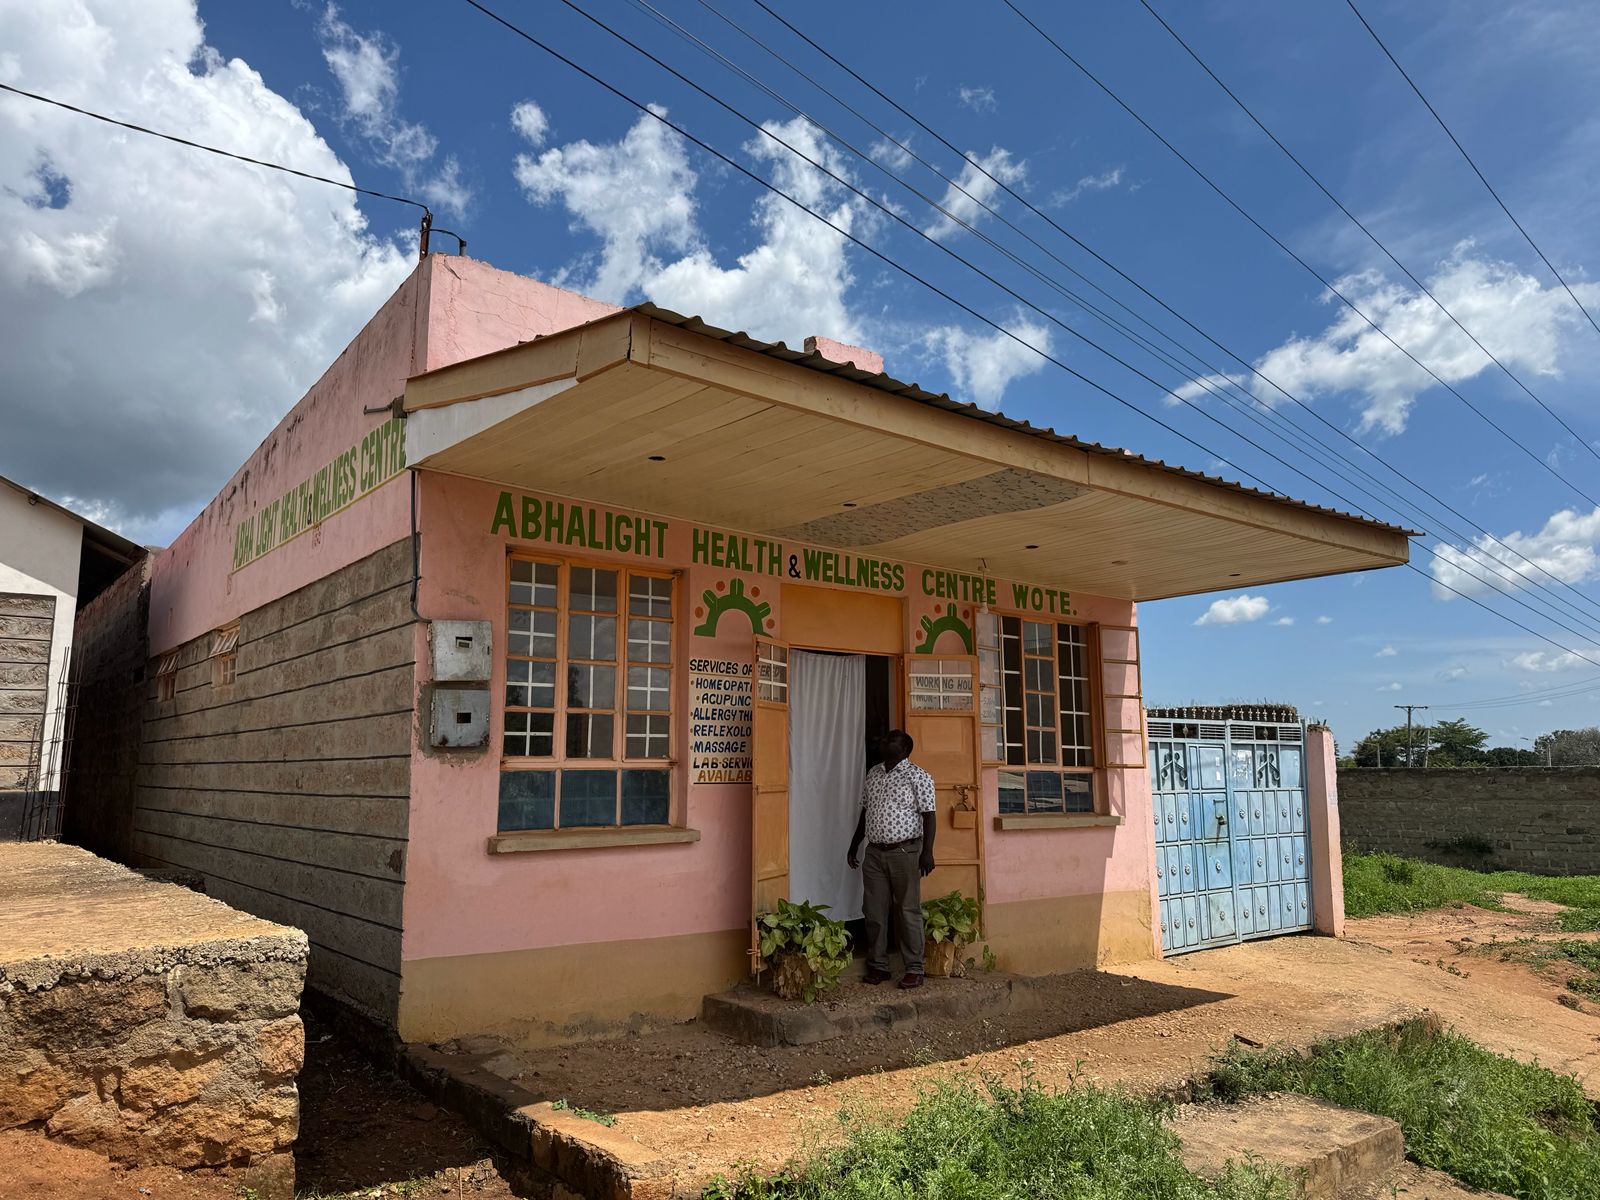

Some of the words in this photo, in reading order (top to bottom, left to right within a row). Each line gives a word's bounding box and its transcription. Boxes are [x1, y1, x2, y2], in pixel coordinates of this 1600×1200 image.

[232, 514, 254, 571] ABHA
[255, 498, 280, 557] LIGHT
[279, 478, 309, 543] HEALTH
[307, 492, 313, 525] &
[312, 445, 357, 522] WELLNESS
[360, 417, 406, 493] CENTRE
[490, 491, 668, 558] ABHALIGHT
[692, 528, 783, 577] HEALTH
[788, 554, 801, 579] &
[803, 548, 905, 592] WELLNESS
[921, 569, 997, 605] CENTRE
[1012, 583, 1078, 616] WOTE.
[689, 659, 738, 675] SERVICES
[915, 676, 954, 690] WORKNG
[957, 680, 972, 690] HOU
[702, 693, 752, 706] ACUPUNC
[693, 707, 737, 721] ALLERGY
[694, 724, 752, 737] REFLEXOLO
[693, 741, 746, 753] MASSAGE
[698, 770, 752, 782] AVAILAB
